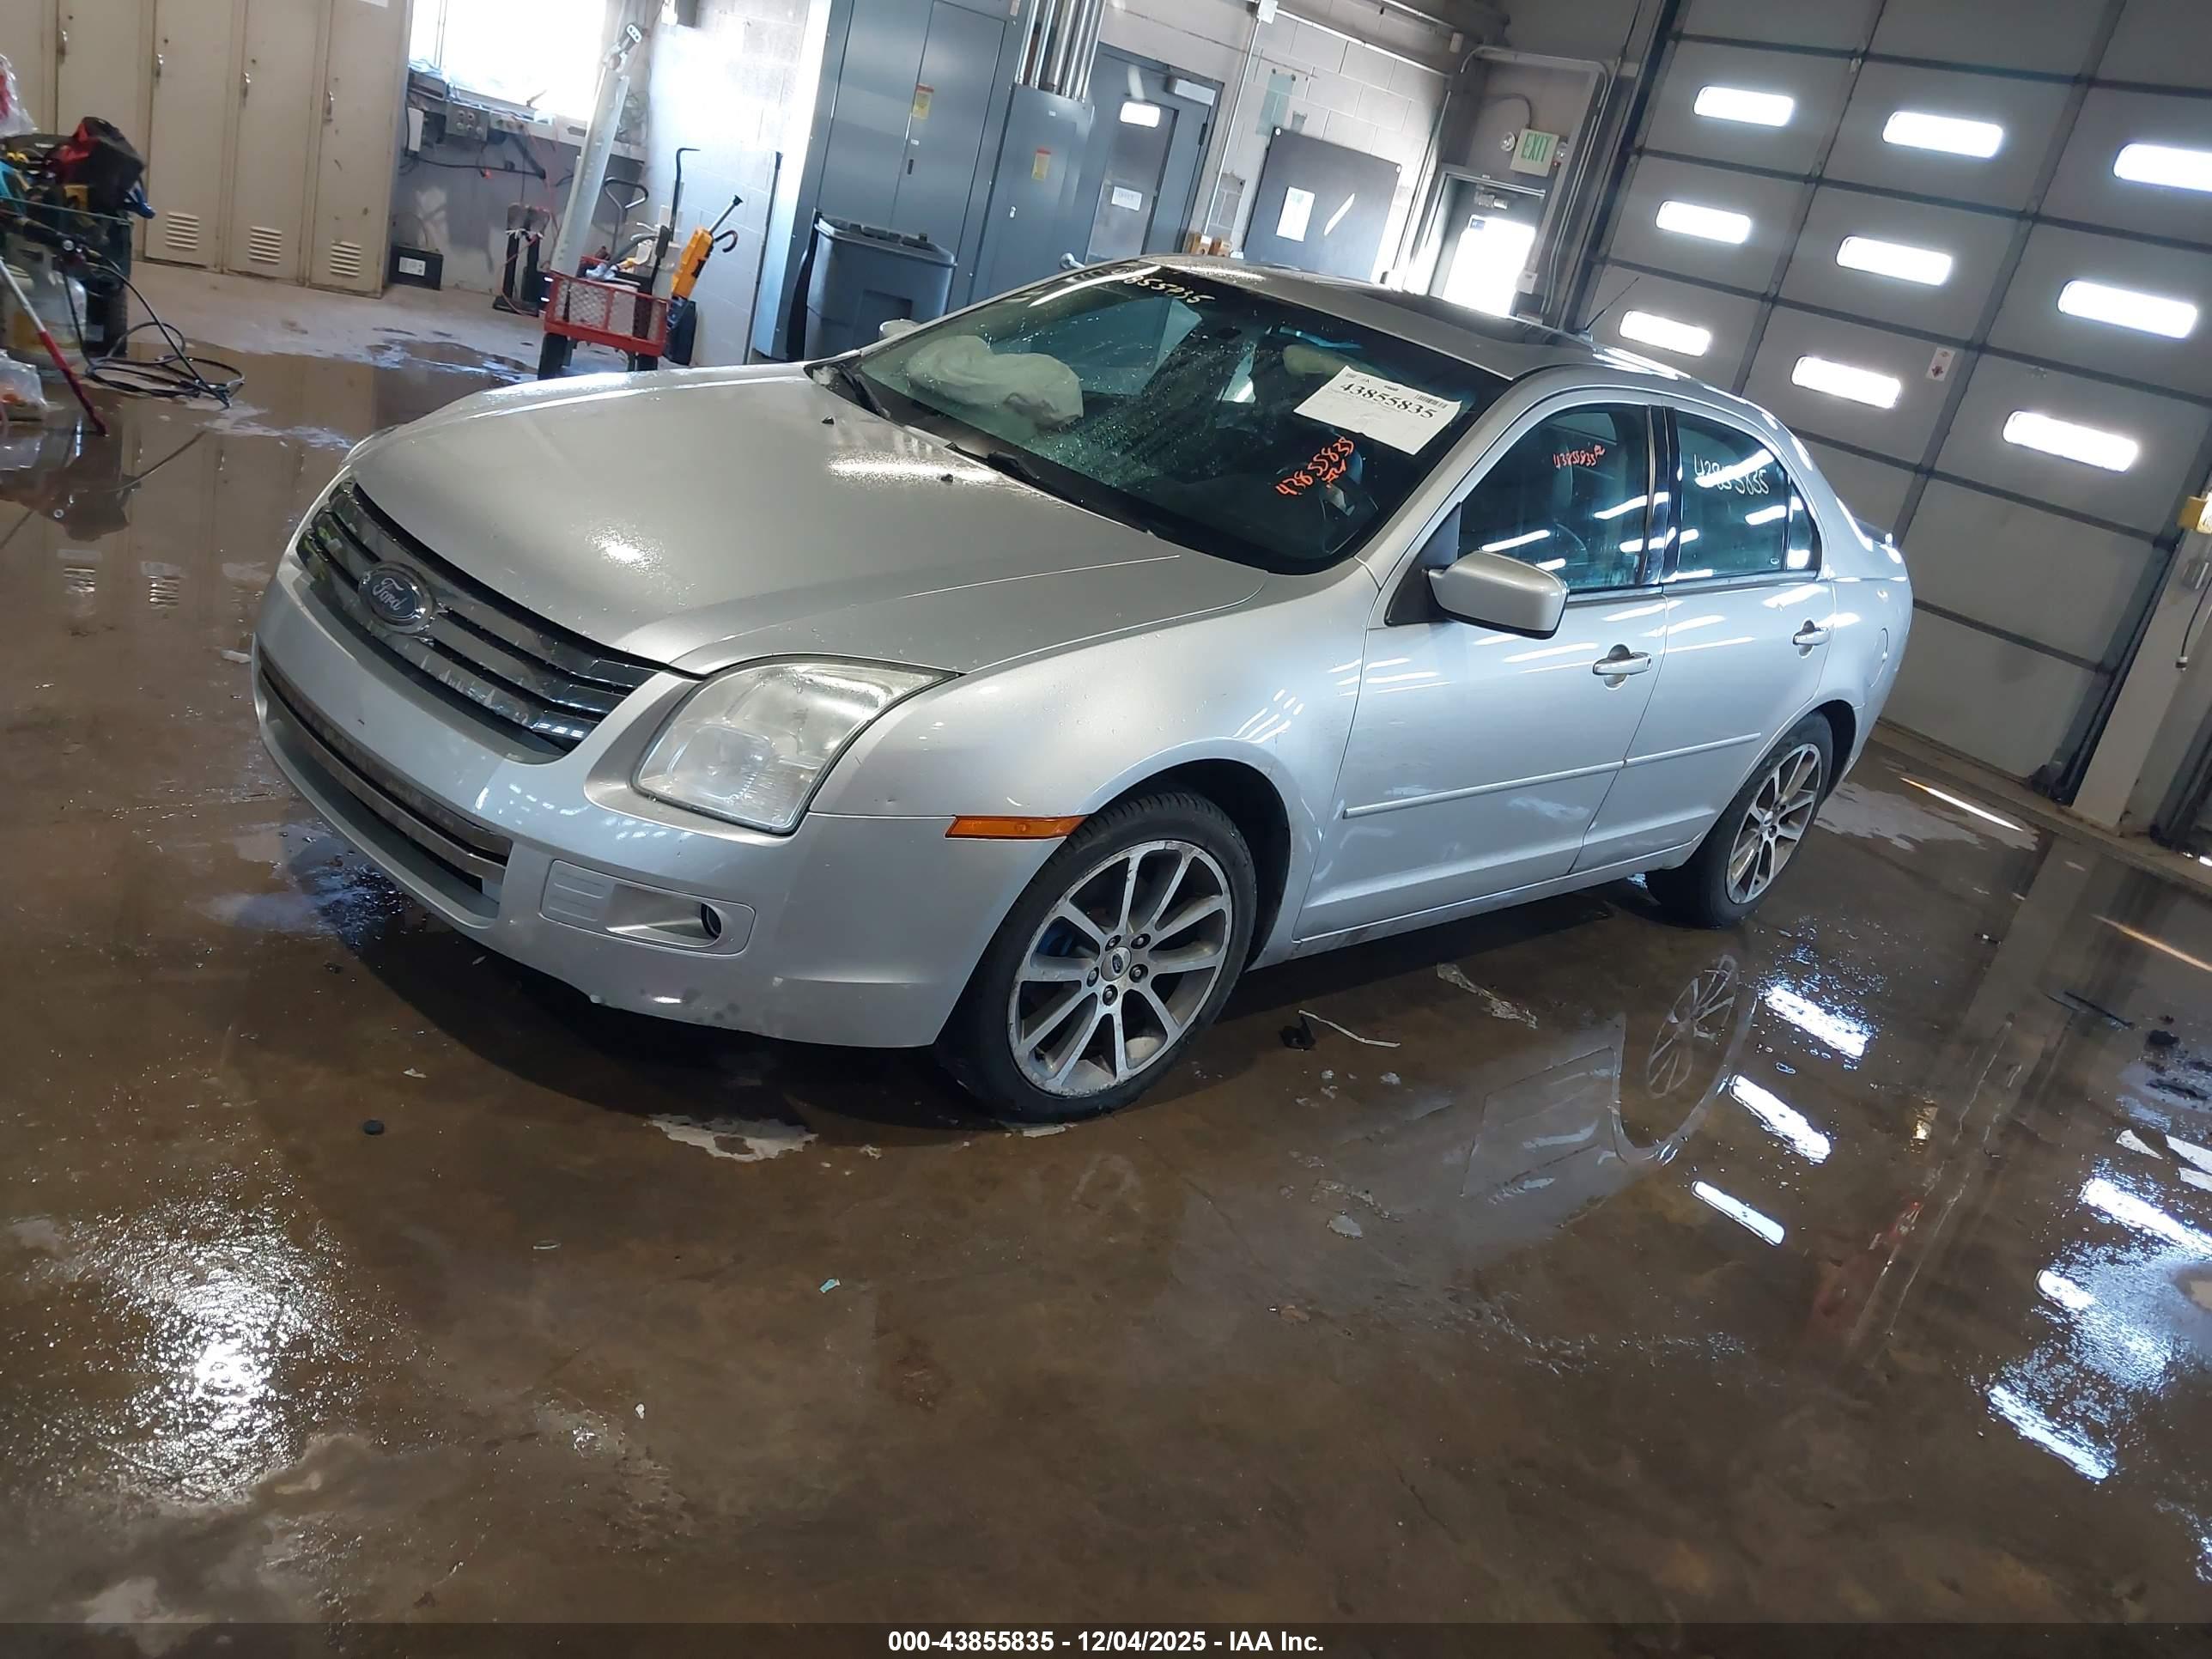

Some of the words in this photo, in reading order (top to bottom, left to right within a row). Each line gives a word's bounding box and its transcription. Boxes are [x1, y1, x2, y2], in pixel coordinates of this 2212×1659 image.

[1521, 132, 1553, 162] EXIT
[1340, 383, 1437, 419] 43855835
[1275, 436, 1354, 495] 43855835
[372, 577, 408, 611] Ford
